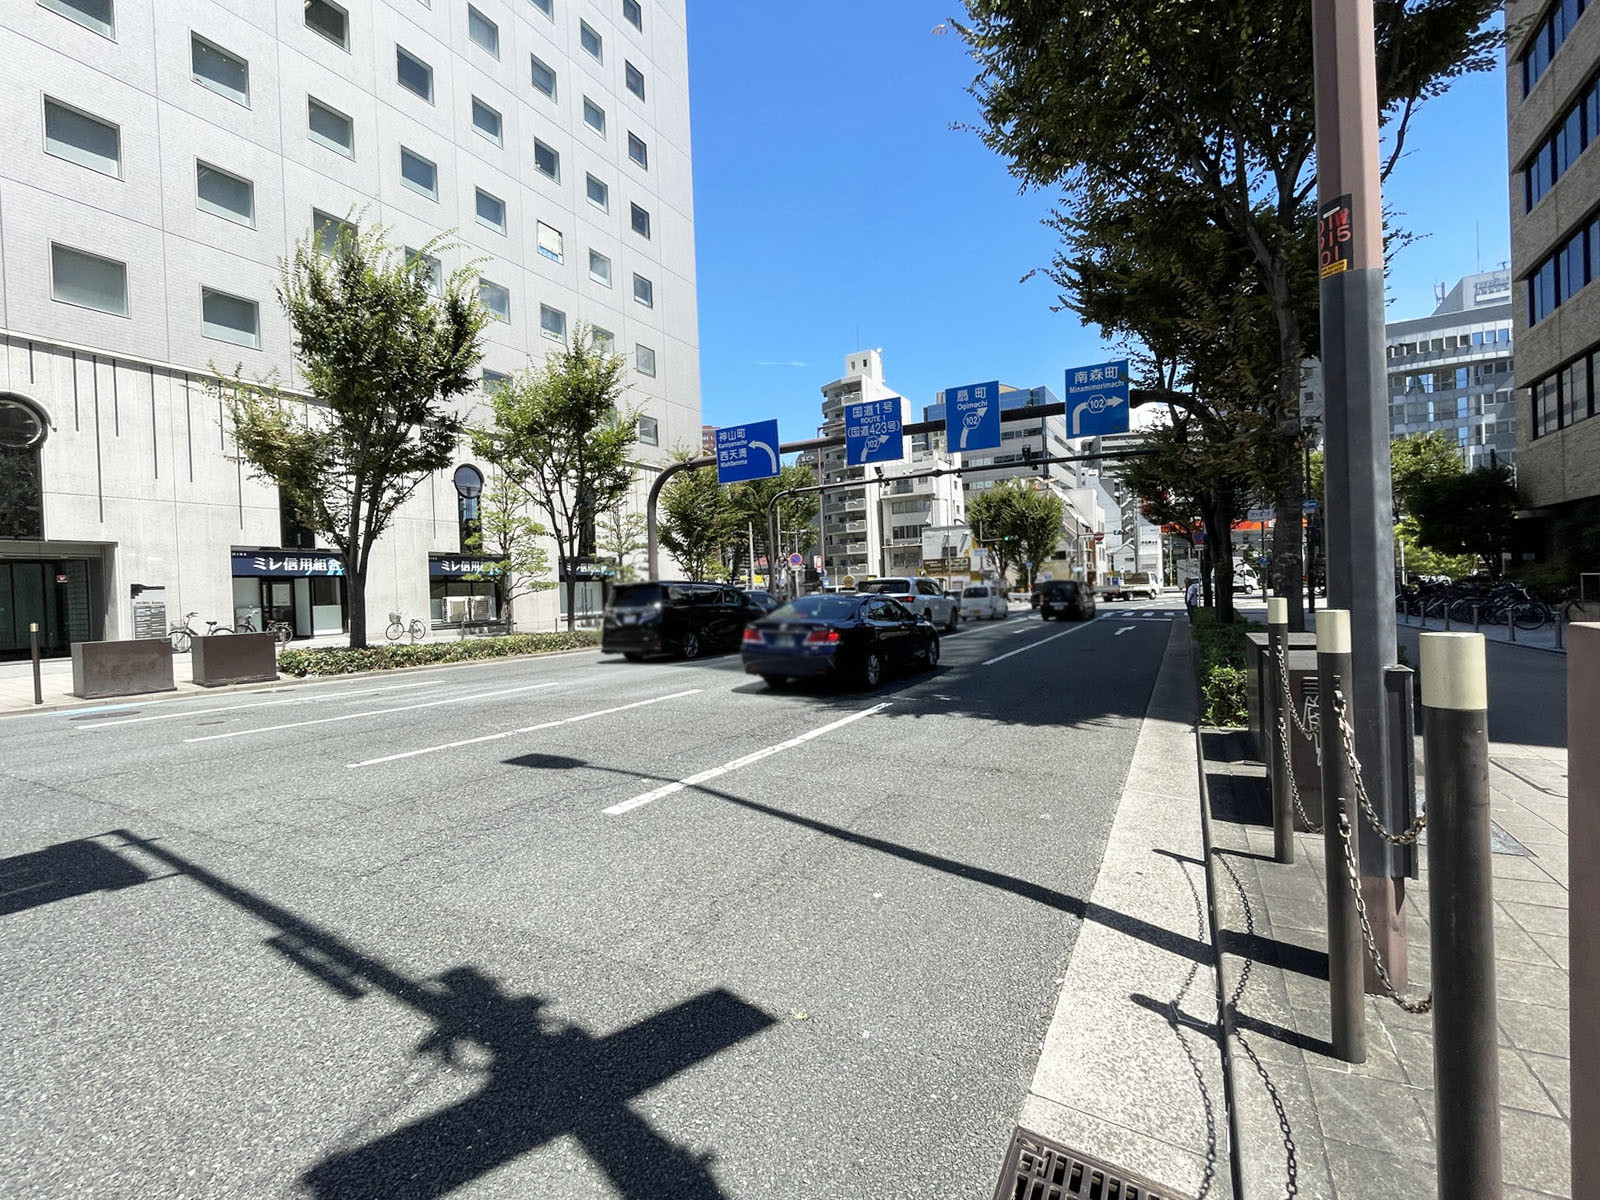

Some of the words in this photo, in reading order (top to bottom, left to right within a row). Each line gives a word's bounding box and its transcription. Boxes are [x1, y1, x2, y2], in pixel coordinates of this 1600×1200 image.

[1075, 366, 1119, 385] 南森町
[1069, 381, 1125, 394] Minamimorimachi
[957, 387, 987, 402] 扇町
[852, 401, 894, 419] 国道1号
[957, 400, 988, 411] Ogimachi
[1090, 399, 1104, 409] 102
[860, 415, 881, 424] ROUTE
[966, 416, 978, 425] 102
[719, 428, 746, 442] 神山町
[848, 420, 901, 438] (国道423号)
[867, 440, 878, 448] 102
[720, 448, 747, 461] 西天満
[253, 557, 342, 571] ミレ信用組合
